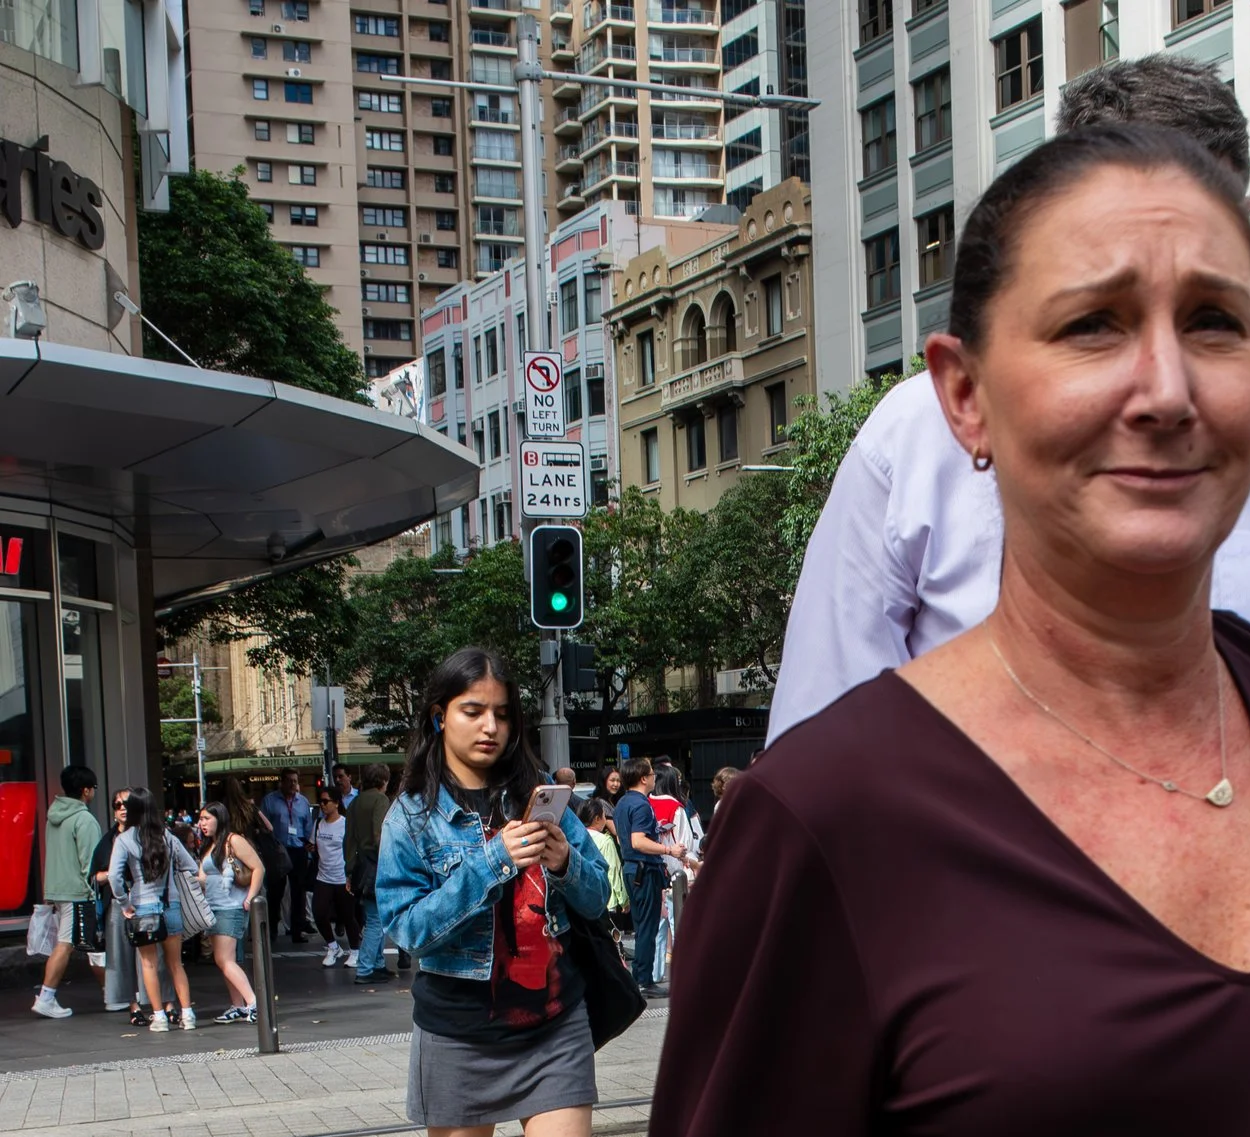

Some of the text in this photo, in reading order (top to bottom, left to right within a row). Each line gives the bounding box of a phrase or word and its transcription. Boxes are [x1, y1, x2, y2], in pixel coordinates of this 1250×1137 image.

[0, 134, 105, 251] ries
[534, 394, 555, 408] NO
[532, 410, 558, 420] LEFT
[532, 422, 560, 432] TURN
[527, 452, 537, 466] B
[529, 473, 577, 487] LANE
[527, 493, 581, 507] 24hrs
